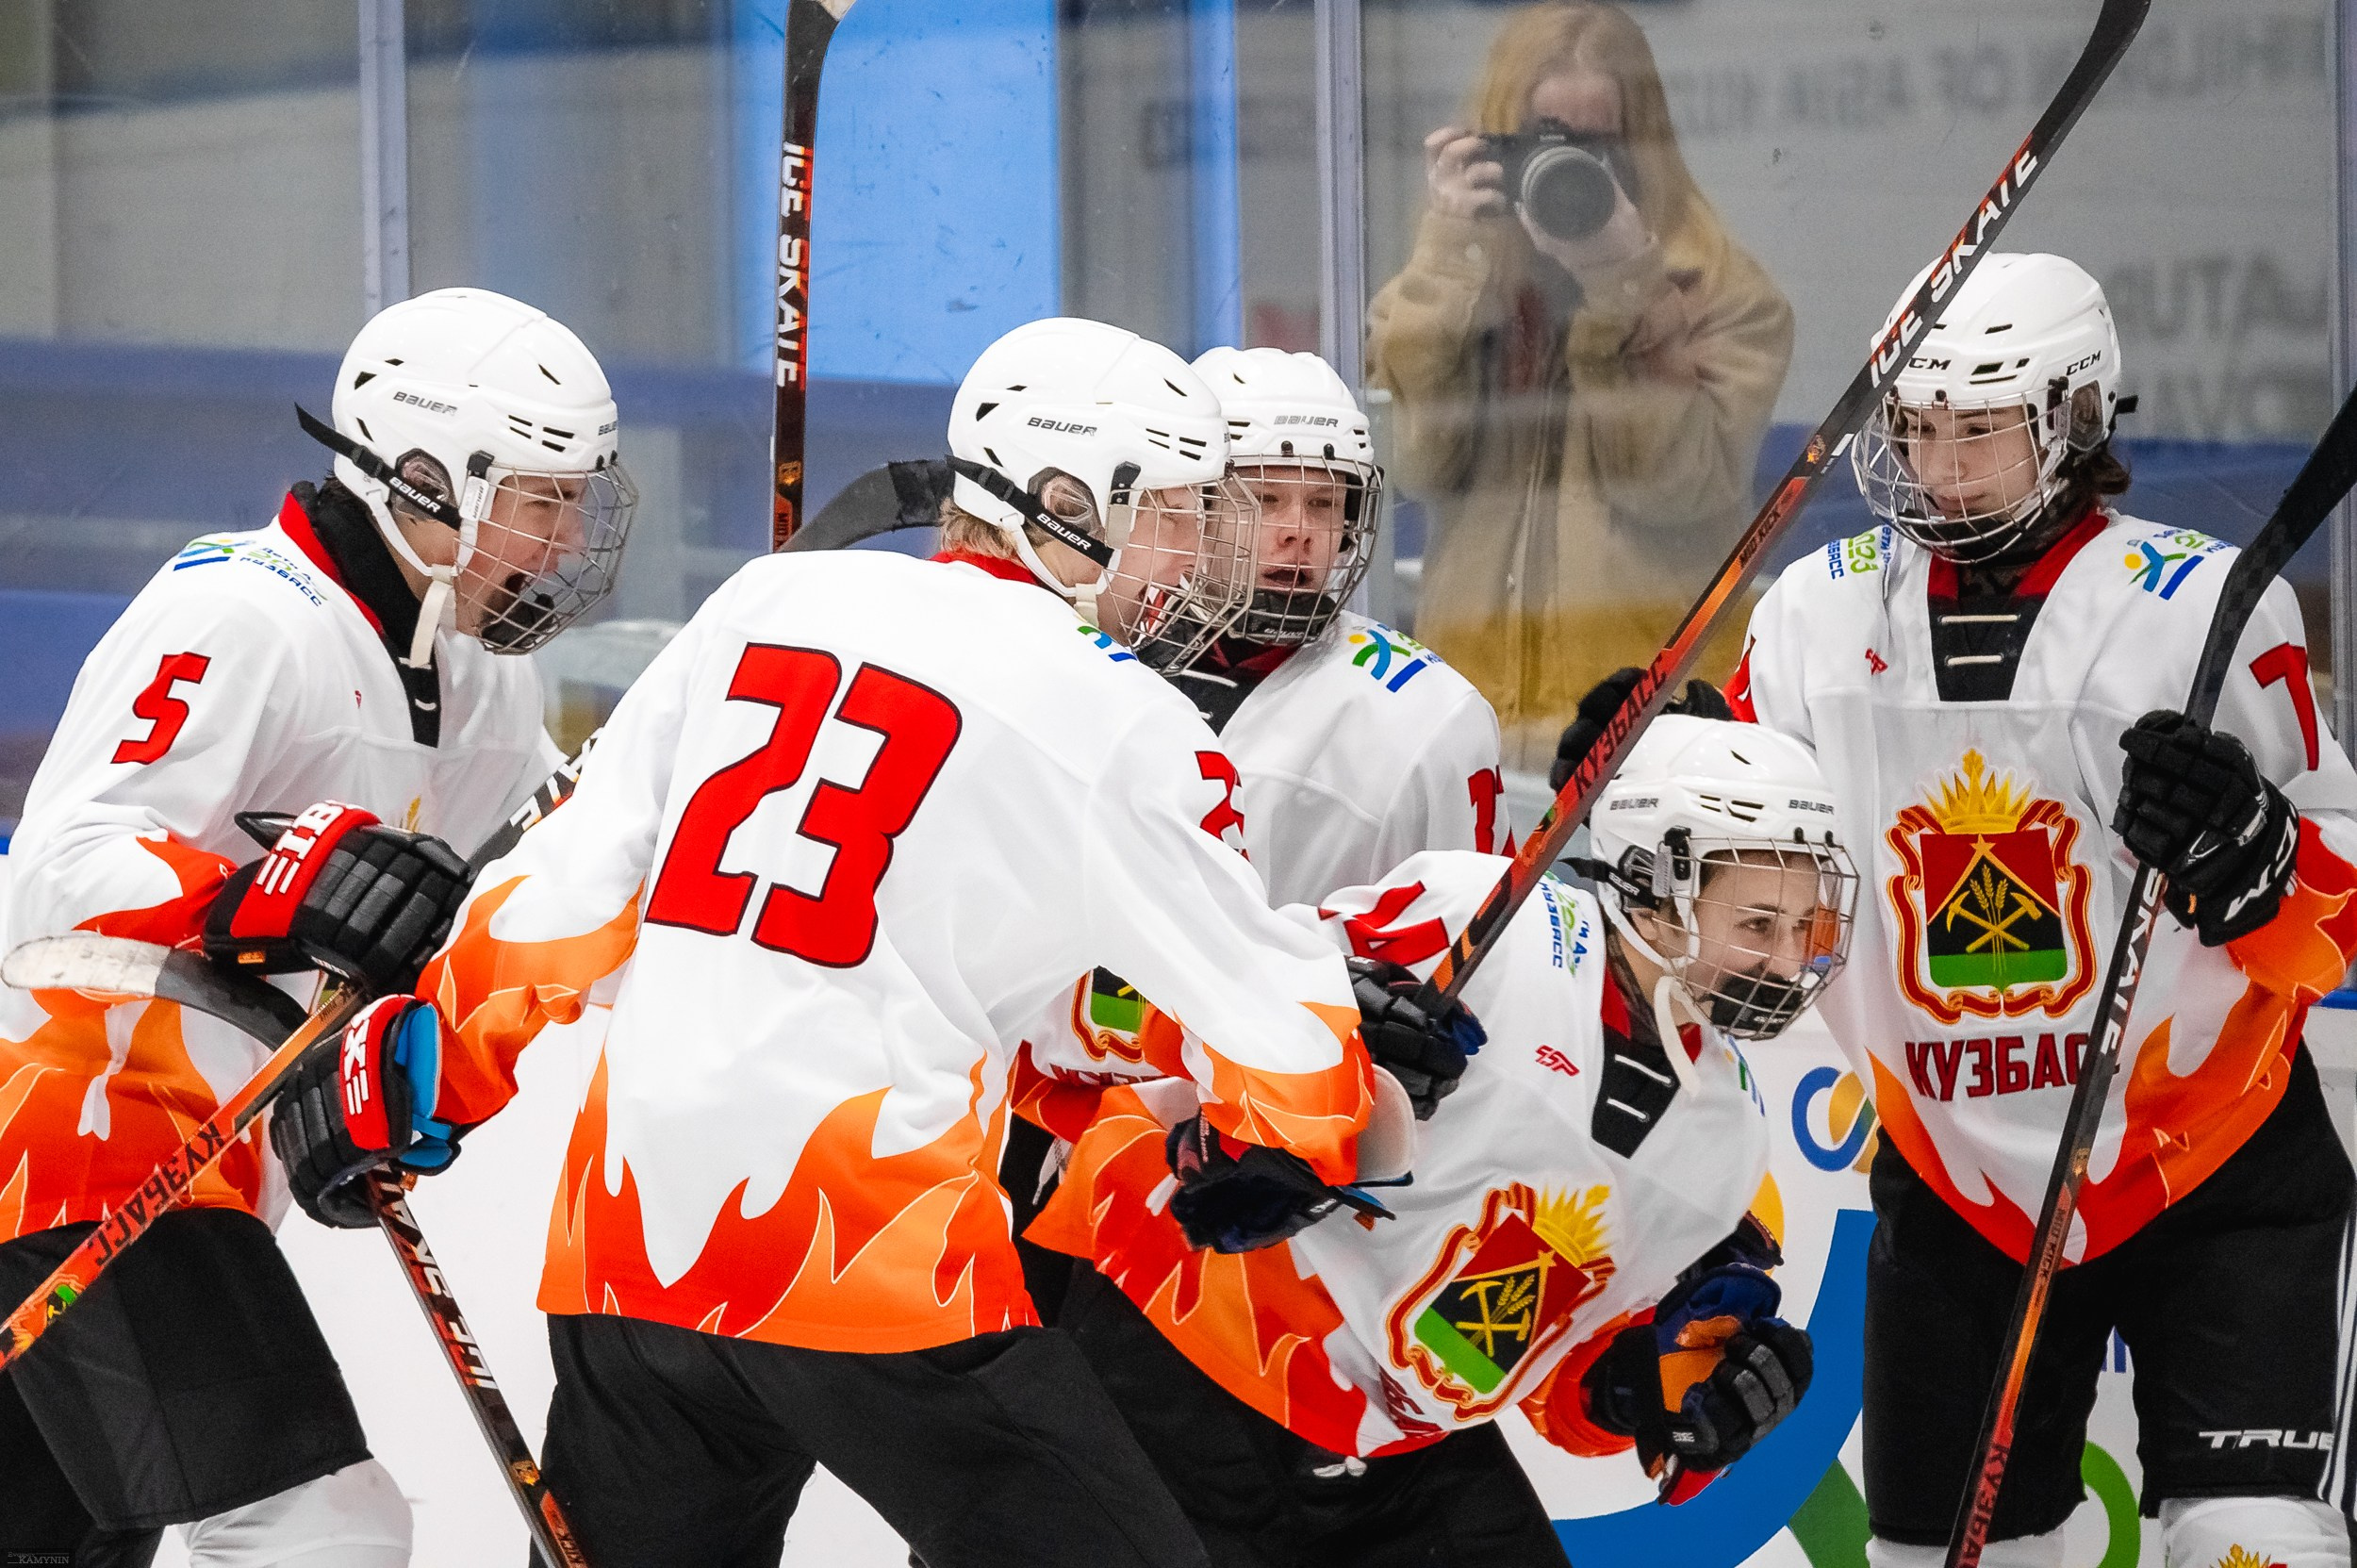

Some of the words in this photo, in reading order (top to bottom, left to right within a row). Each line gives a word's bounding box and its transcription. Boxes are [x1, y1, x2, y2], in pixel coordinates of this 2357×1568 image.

[782, 140, 809, 217] ICE
[1871, 309, 1924, 388] ICE
[1907, 356, 1952, 371] CM
[2065, 350, 2102, 376] CCM
[392, 390, 458, 417] BAUER
[1273, 414, 1340, 429] BAUER
[1027, 416, 1098, 437] BAUER
[387, 475, 442, 514] BAUER
[1035, 511, 1094, 552] BAUER
[111, 652, 211, 765] 5
[1573, 652, 1667, 800] КУЗБАСС
[644, 643, 963, 969] 23
[1609, 797, 1659, 812] BAUER
[1788, 799, 1836, 816] BAUER
[1607, 871, 1640, 897] BAUER
[1904, 1032, 2121, 1102] КУЗБАС
[87, 1121, 225, 1266] КУЗБАСС
[452, 1313, 499, 1390] ICE
